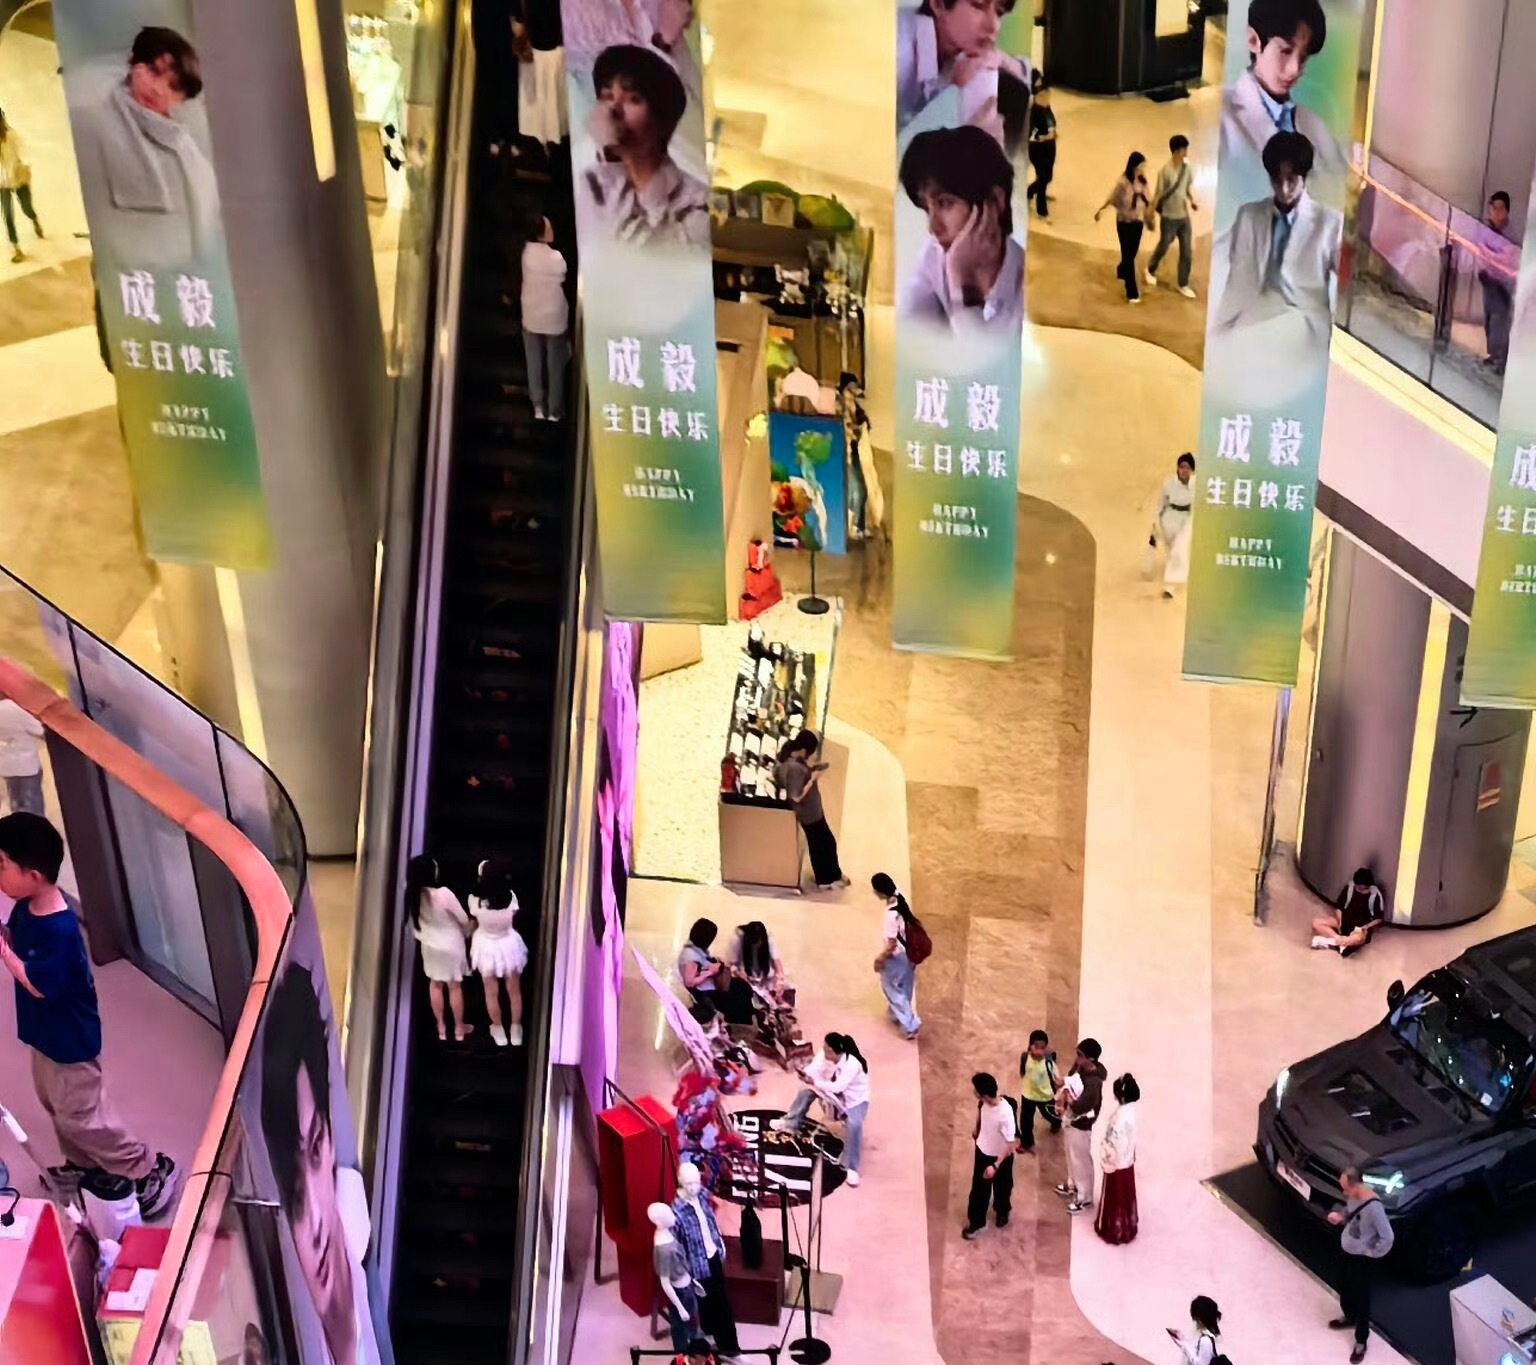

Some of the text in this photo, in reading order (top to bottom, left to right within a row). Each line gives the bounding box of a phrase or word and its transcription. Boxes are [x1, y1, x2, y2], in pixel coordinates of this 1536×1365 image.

[122, 339, 235, 379] 生日快乐
[603, 404, 708, 441] 生日快乐
[906, 442, 1008, 479] 生日快乐
[1206, 477, 1306, 513] 生日快乐
